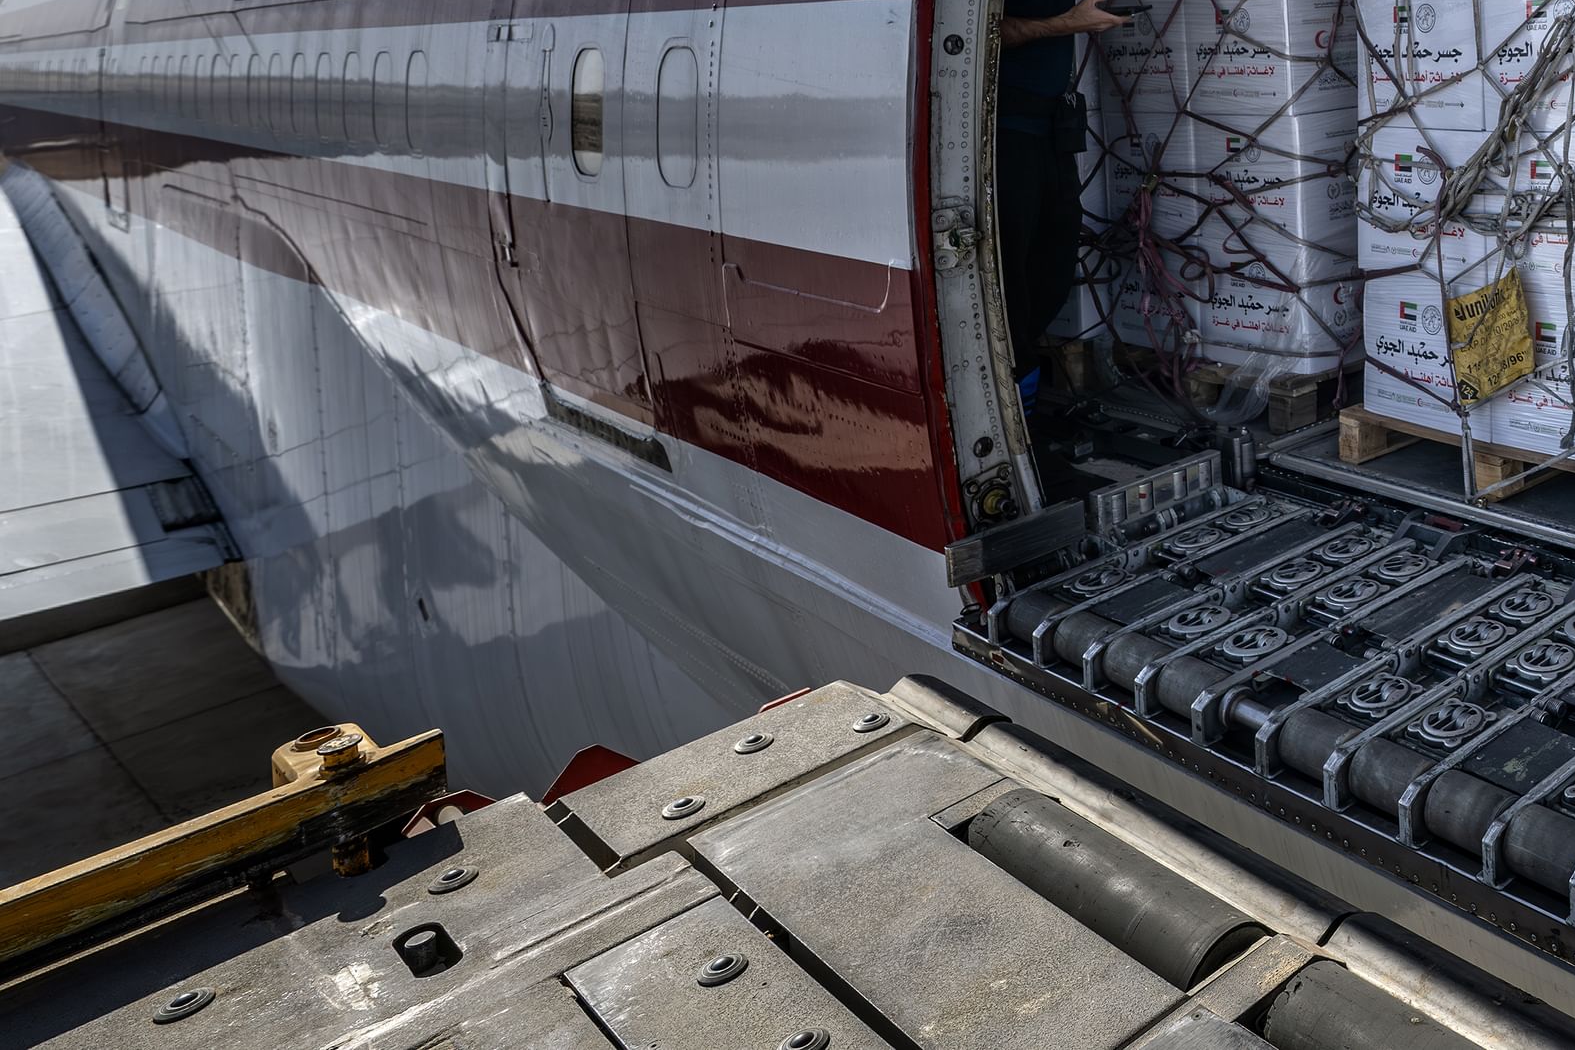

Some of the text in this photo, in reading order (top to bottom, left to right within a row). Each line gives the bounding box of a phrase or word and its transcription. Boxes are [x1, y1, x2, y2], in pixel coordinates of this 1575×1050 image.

[1433, 48, 1462, 62] جسر
[1497, 42, 1532, 64] الجوي
[1238, 295, 1263, 315] حميد
[1376, 335, 1438, 364] حميد الجوي
